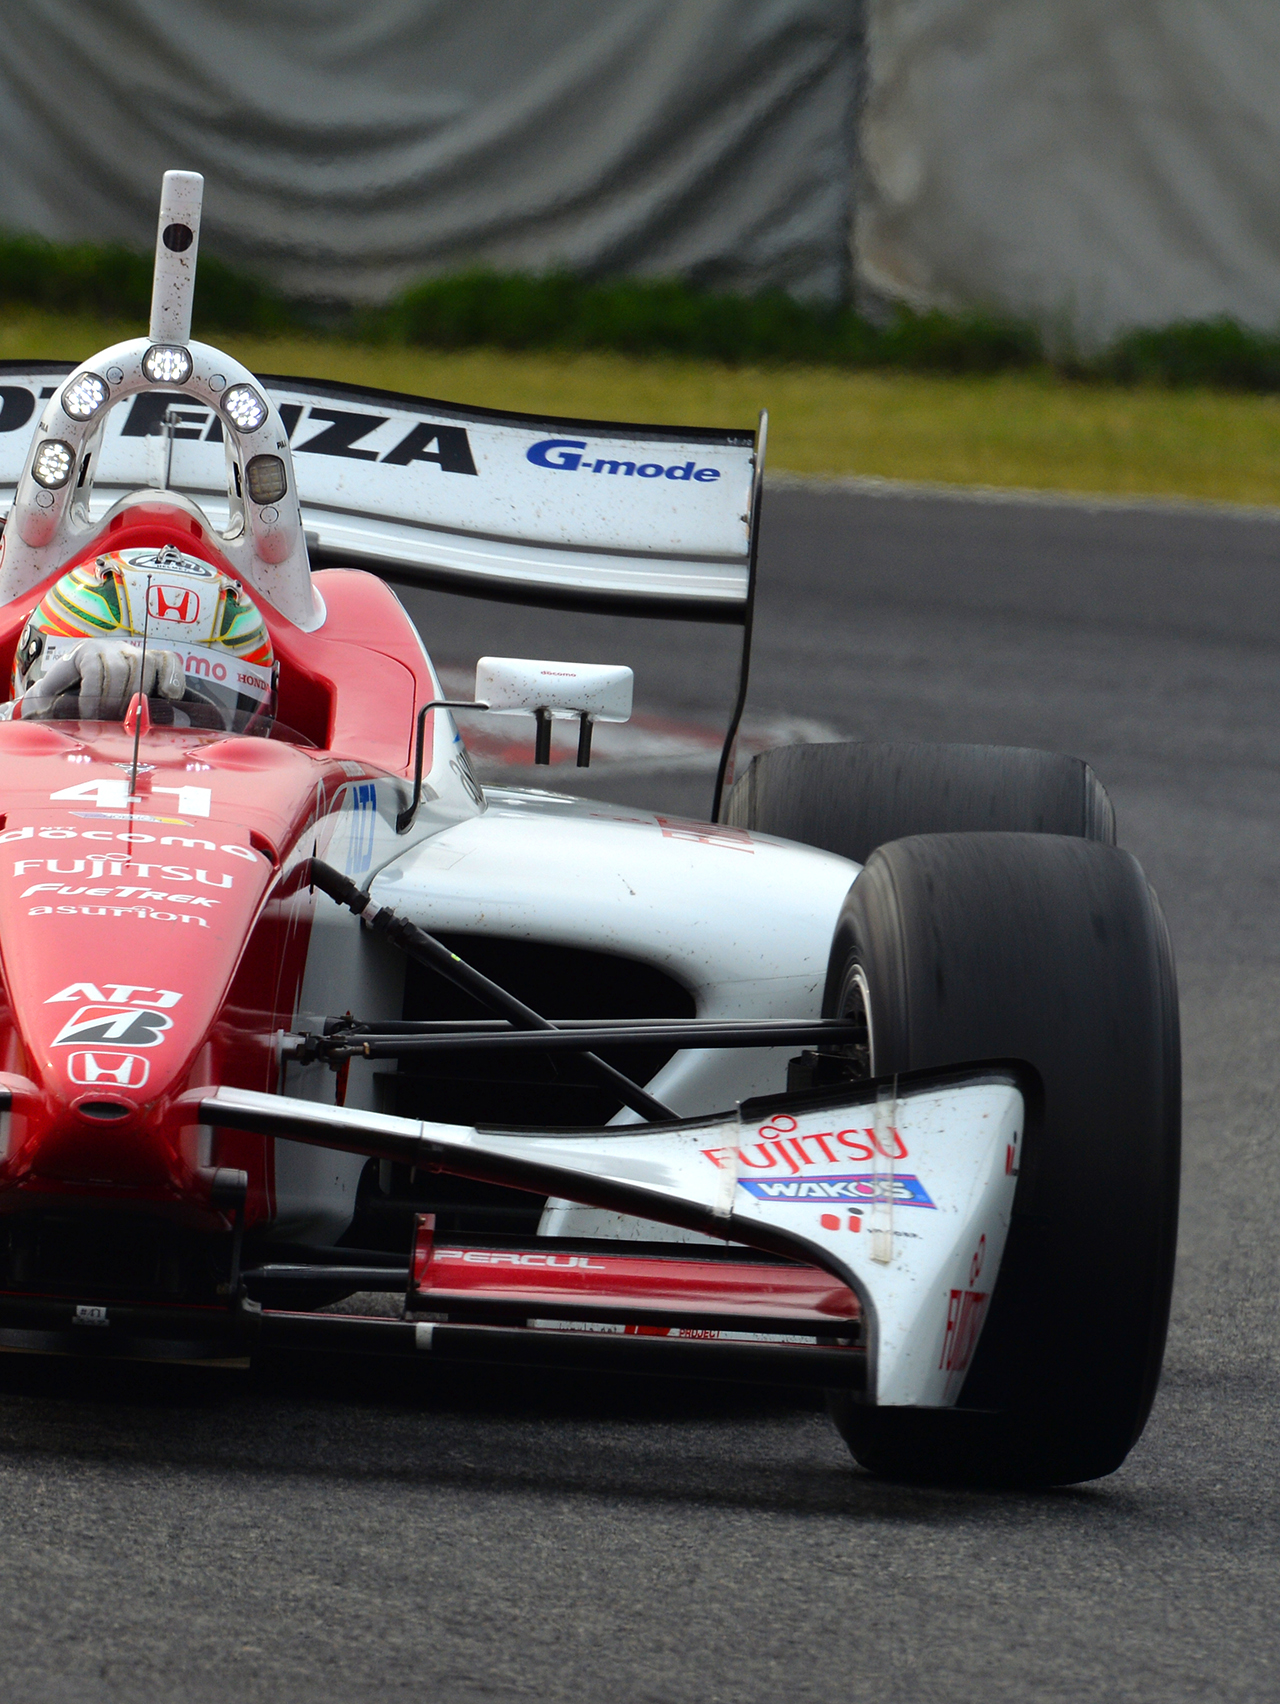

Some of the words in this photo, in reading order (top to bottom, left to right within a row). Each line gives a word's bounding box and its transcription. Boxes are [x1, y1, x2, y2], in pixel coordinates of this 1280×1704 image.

[526, 438, 721, 483] G-mode
[49, 778, 212, 818] 41
[12, 857, 235, 889] FUJITSU
[28, 904, 211, 929] asurion
[699, 1126, 910, 1175] FUJITSU
[433, 1248, 607, 1271] PERCUL
[678, 1328, 720, 1340] PROJECT
